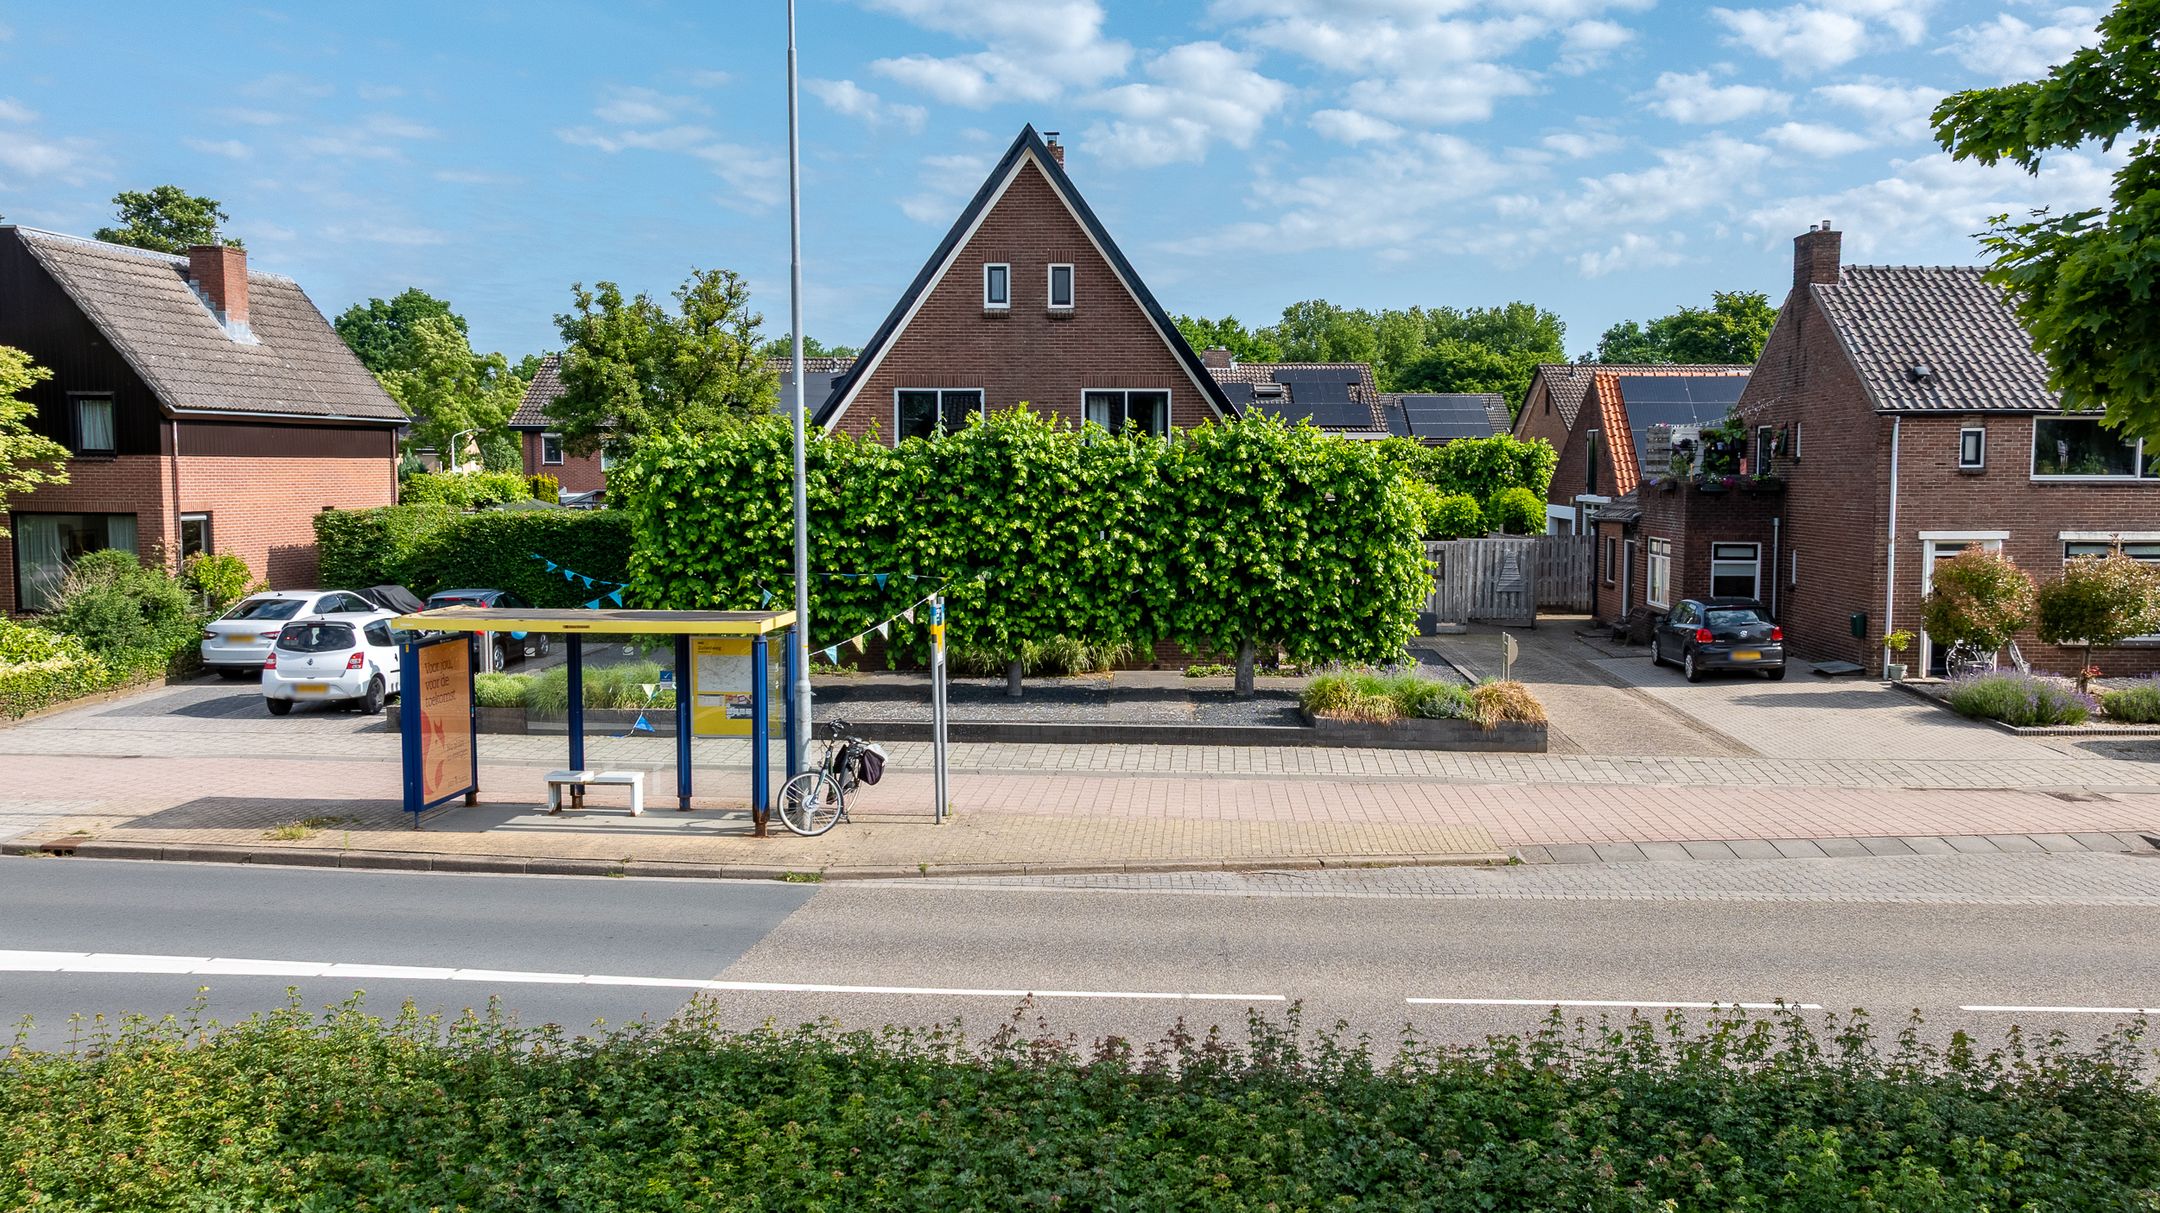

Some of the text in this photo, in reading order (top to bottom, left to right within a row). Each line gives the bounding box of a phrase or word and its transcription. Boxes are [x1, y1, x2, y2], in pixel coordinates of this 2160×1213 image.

[424, 661, 440, 674] Voor
[425, 673, 450, 690] voor de
[425, 689, 456, 708] toekomst
